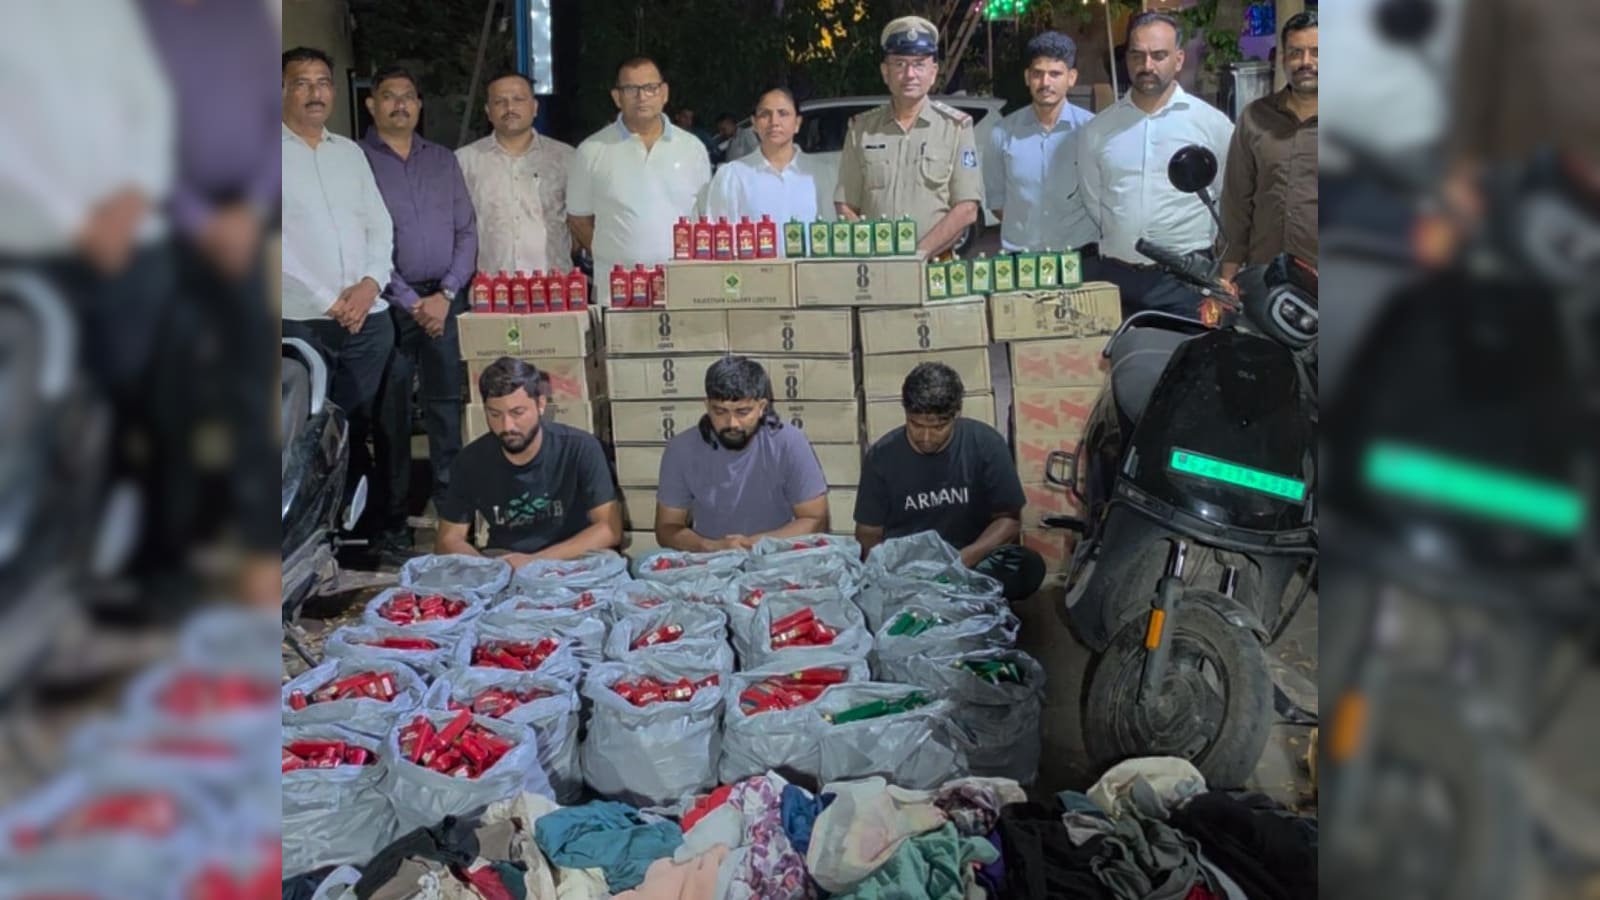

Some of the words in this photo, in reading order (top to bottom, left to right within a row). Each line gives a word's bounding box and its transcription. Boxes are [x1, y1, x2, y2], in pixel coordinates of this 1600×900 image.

[856, 263, 870, 288] 8
[659, 312, 671, 337] 8
[662, 358, 675, 382] 8
[904, 487, 969, 511] ARMANI
